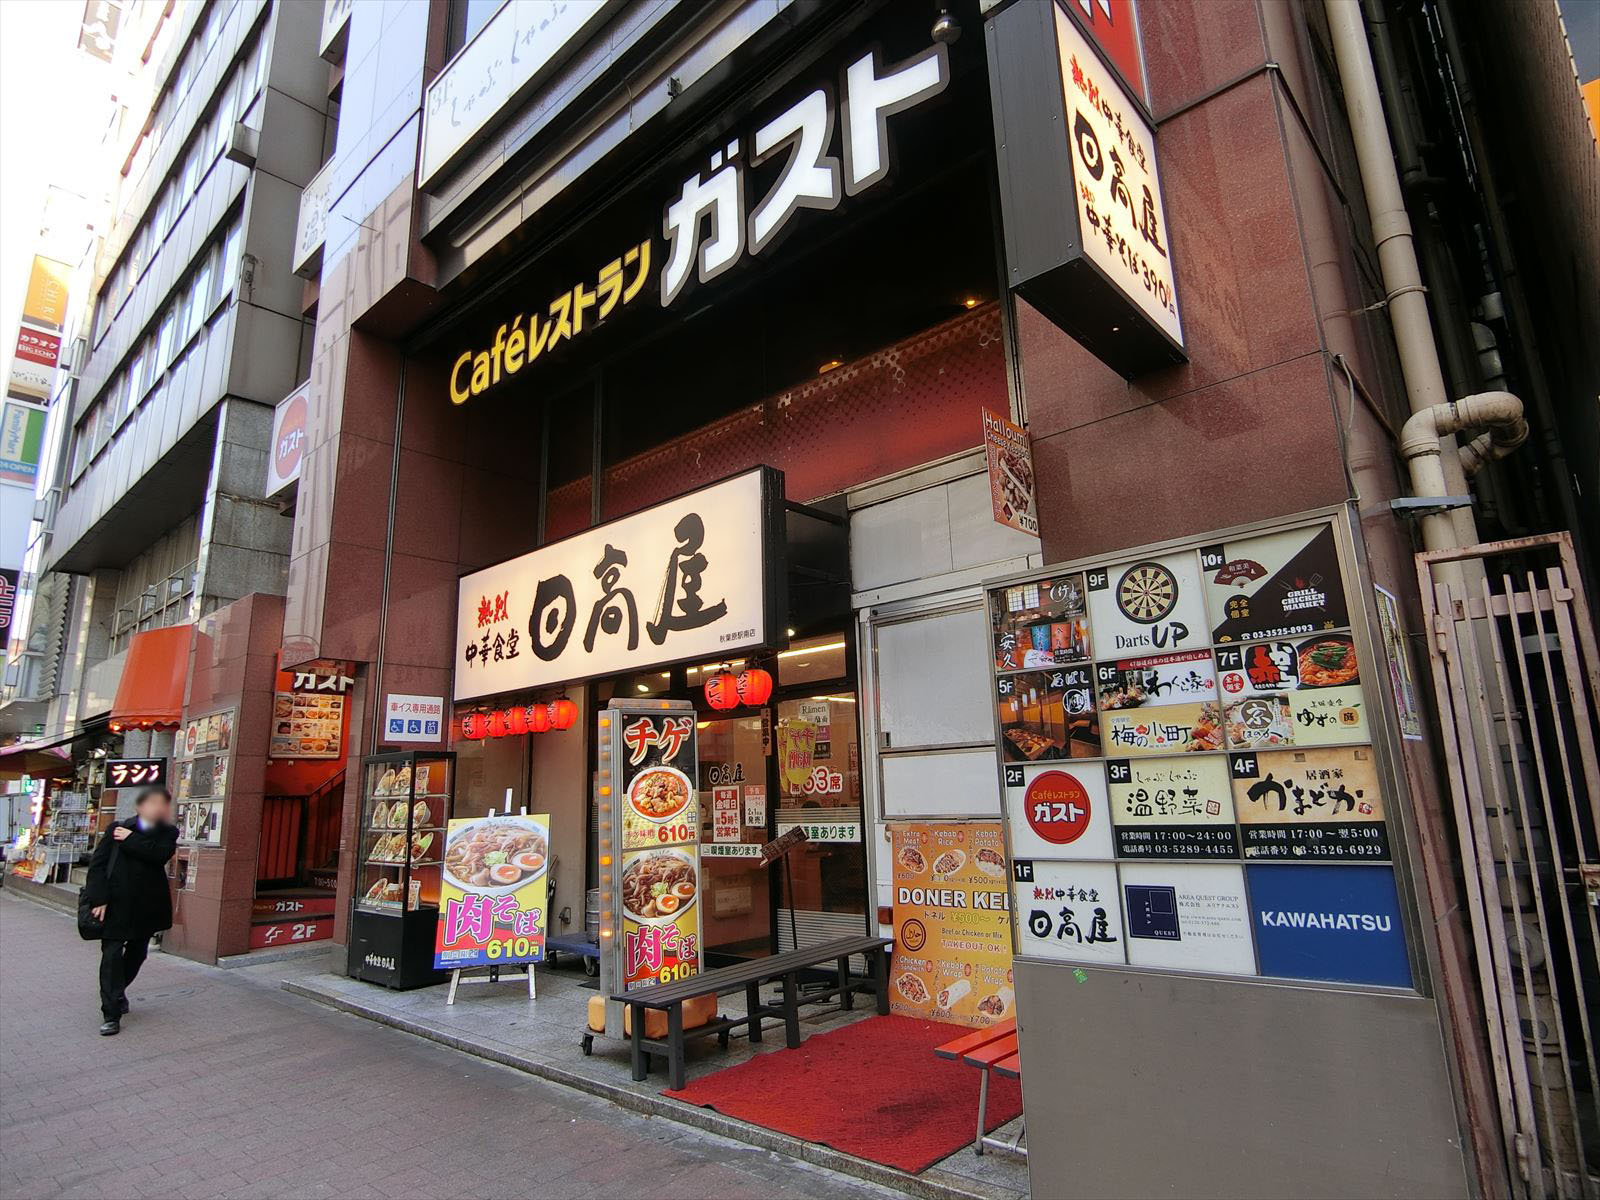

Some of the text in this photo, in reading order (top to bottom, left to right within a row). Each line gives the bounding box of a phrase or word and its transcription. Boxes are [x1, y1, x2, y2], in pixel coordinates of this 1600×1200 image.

[661, 43, 948, 307] ガスト
[1074, 108, 1167, 258] 日高屋
[449, 238, 652, 406] Caféレストラン
[20, 334, 59, 349] カラオケ
[7, 409, 24, 454] FamilyMart
[985, 411, 1029, 449] Halloumi
[279, 428, 304, 460] ガスト
[1020, 516, 1038, 531] ¥700
[1202, 554, 1222, 567] 10F
[528, 512, 728, 661] 日高屋
[1089, 574, 1106, 586] 9F
[1281, 593, 1325, 605] CHICKEN
[1287, 588, 1317, 597] GRILL
[477, 590, 509, 628] 熱烈
[1229, 599, 1249, 609] 完全
[1283, 600, 1325, 611] MARKET
[1231, 609, 1249, 619] 個室
[1115, 622, 1189, 649] Darts UP
[1253, 624, 1313, 639] 03-3525-8993
[465, 628, 520, 668] 中華食堂
[1218, 652, 1238, 666] 7F
[1099, 668, 1116, 680] 6F
[999, 680, 1013, 694] 5F
[391, 702, 440, 715] 車イス専用通路
[1112, 722, 1192, 747] 梅の小町
[624, 717, 693, 766] チゲ
[1110, 766, 1128, 778] 3F
[1234, 759, 1255, 773] 4F
[709, 762, 746, 784] 日高屋
[1007, 771, 1022, 782] 2F
[1247, 773, 1364, 815] かまどか
[716, 799, 737, 809] 金曜日
[1127, 786, 1202, 816] 温野菜
[1034, 802, 1085, 823] ガスト
[716, 826, 738, 837] 営業中
[934, 830, 957, 838] Kebab
[975, 830, 998, 838] Kebab
[1121, 832, 1151, 840] 営業時間
[1249, 830, 1286, 839] 営業時間
[938, 838, 954, 846] Rice
[975, 839, 999, 847] Potato
[711, 846, 757, 855] 喫煙室あります
[1123, 845, 1233, 854] 電話番号 03-5289-4455
[1292, 845, 1382, 856] 03-3526-6929
[1016, 864, 1030, 877] 1F
[968, 876, 988, 884] ¥500
[898, 887, 967, 908] DONER
[275, 901, 304, 912] ガスト
[445, 893, 542, 946] 肉そば
[1028, 906, 1117, 944] 日高屋
[1261, 911, 1391, 932] KAWAHATSU
[291, 924, 316, 940] 2F
[961, 929, 984, 937] Chicken
[486, 937, 540, 959] 610円
[626, 924, 697, 978] 肉そば
[942, 940, 984, 950] TAKEOUT
[899, 956, 925, 965] Chicken
[941, 960, 963, 969] Kebab
[943, 969, 963, 978] Wrap
[984, 976, 1004, 985] Wrap
[970, 1015, 990, 1025] ¥700
